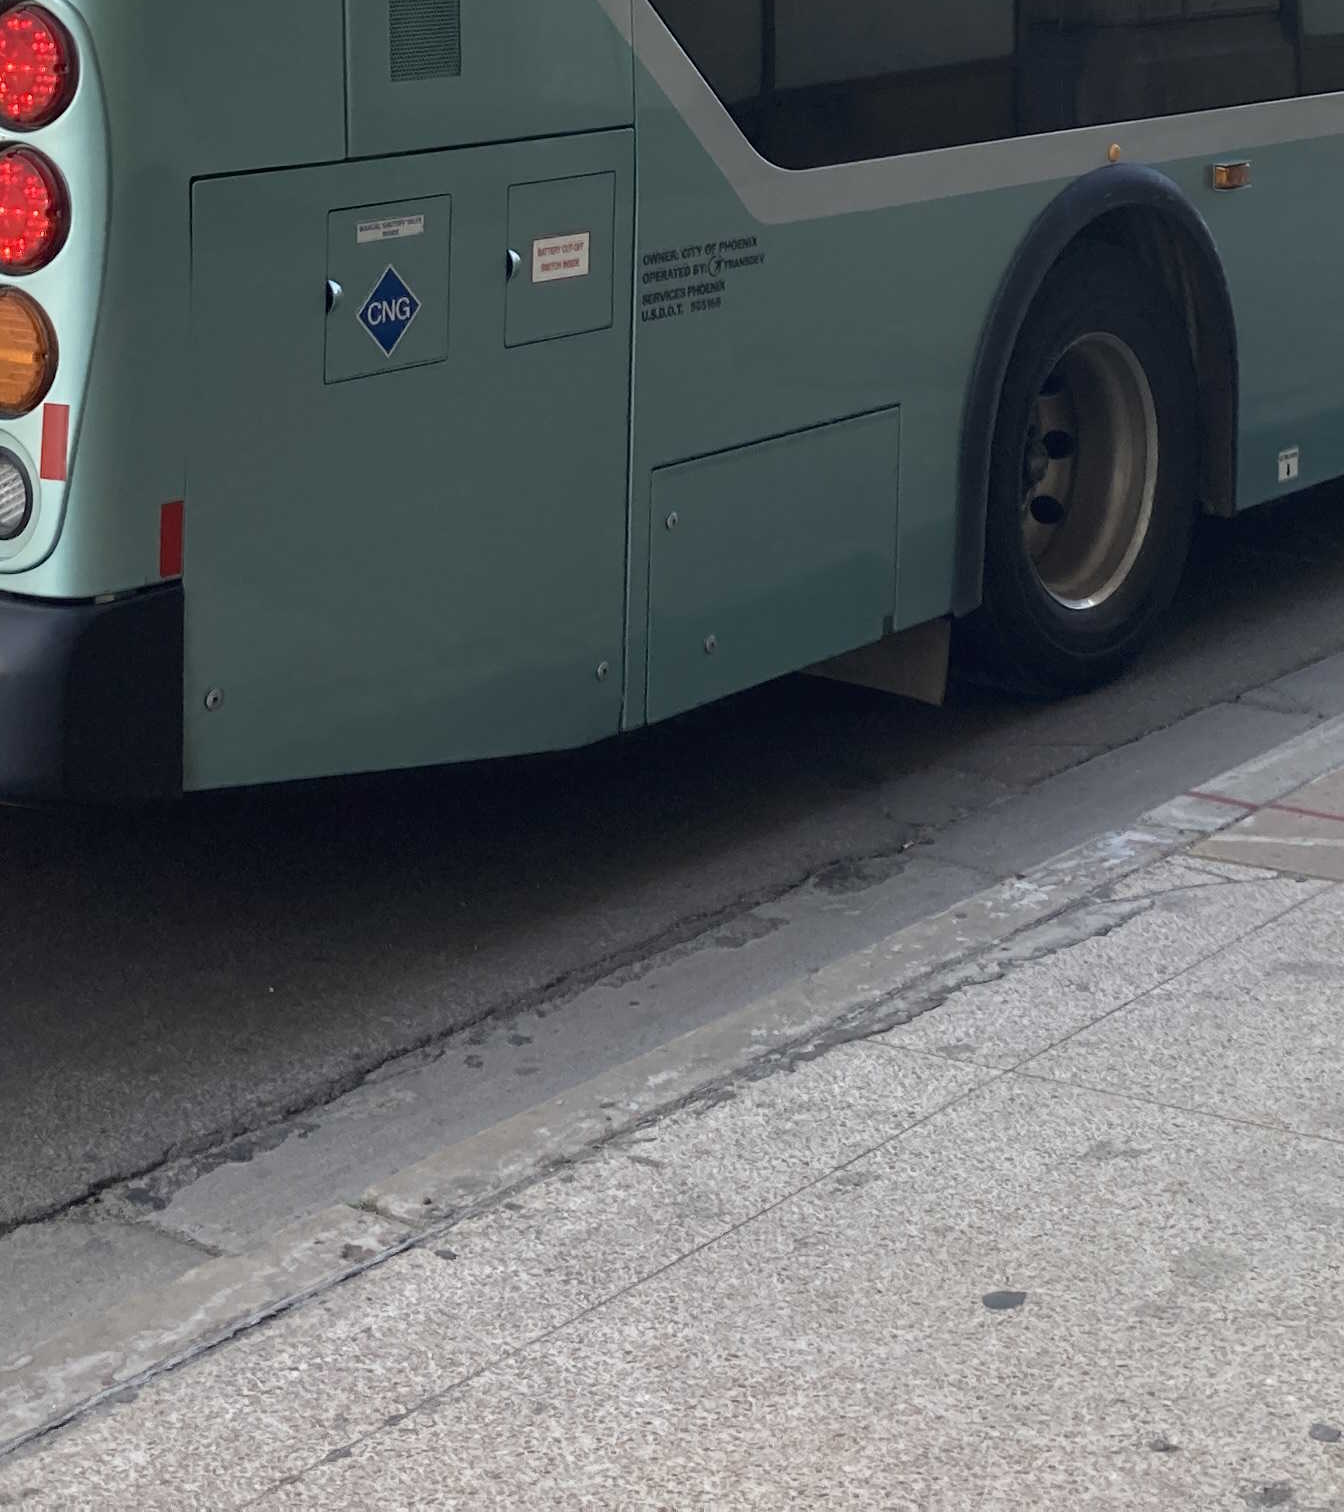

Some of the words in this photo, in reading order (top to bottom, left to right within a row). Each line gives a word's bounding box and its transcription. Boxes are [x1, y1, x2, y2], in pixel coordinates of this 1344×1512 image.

[681, 246, 702, 259] CITY
[704, 243, 717, 256] OF
[718, 236, 758, 253] PHOENIX
[642, 266, 691, 285] OPERATED
[642, 288, 686, 306] SERVICES
[687, 281, 726, 298] PHOENIX
[367, 296, 411, 326] CNG
